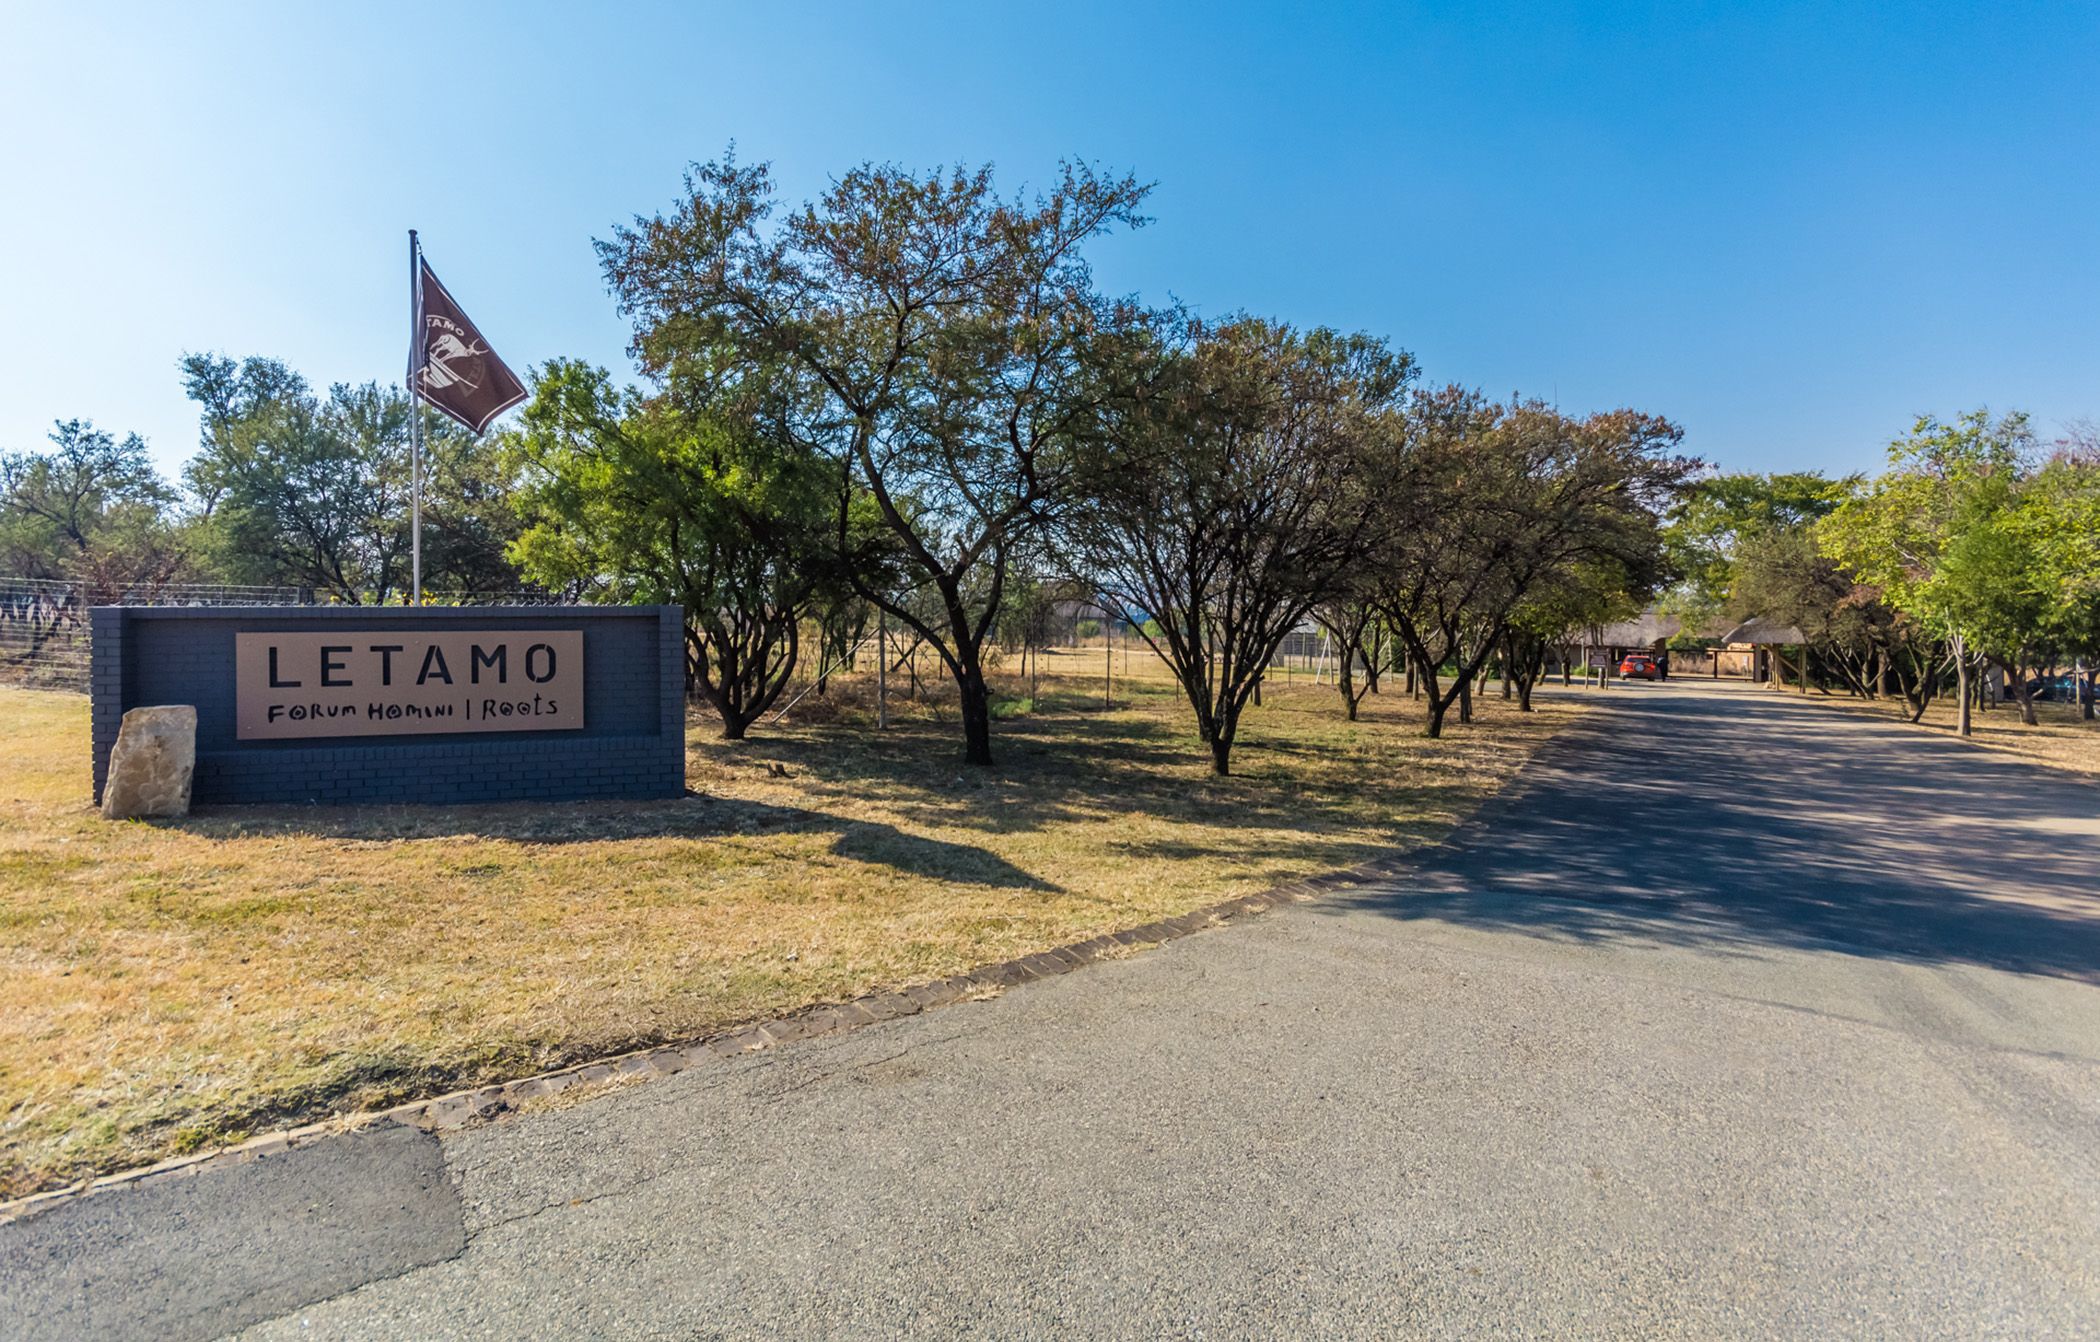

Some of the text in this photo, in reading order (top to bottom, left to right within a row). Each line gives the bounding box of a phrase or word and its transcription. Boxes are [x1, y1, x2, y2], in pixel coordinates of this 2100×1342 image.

[269, 643, 557, 688] LETAMO
[267, 692, 558, 723] FORUM HOMINI Roots
